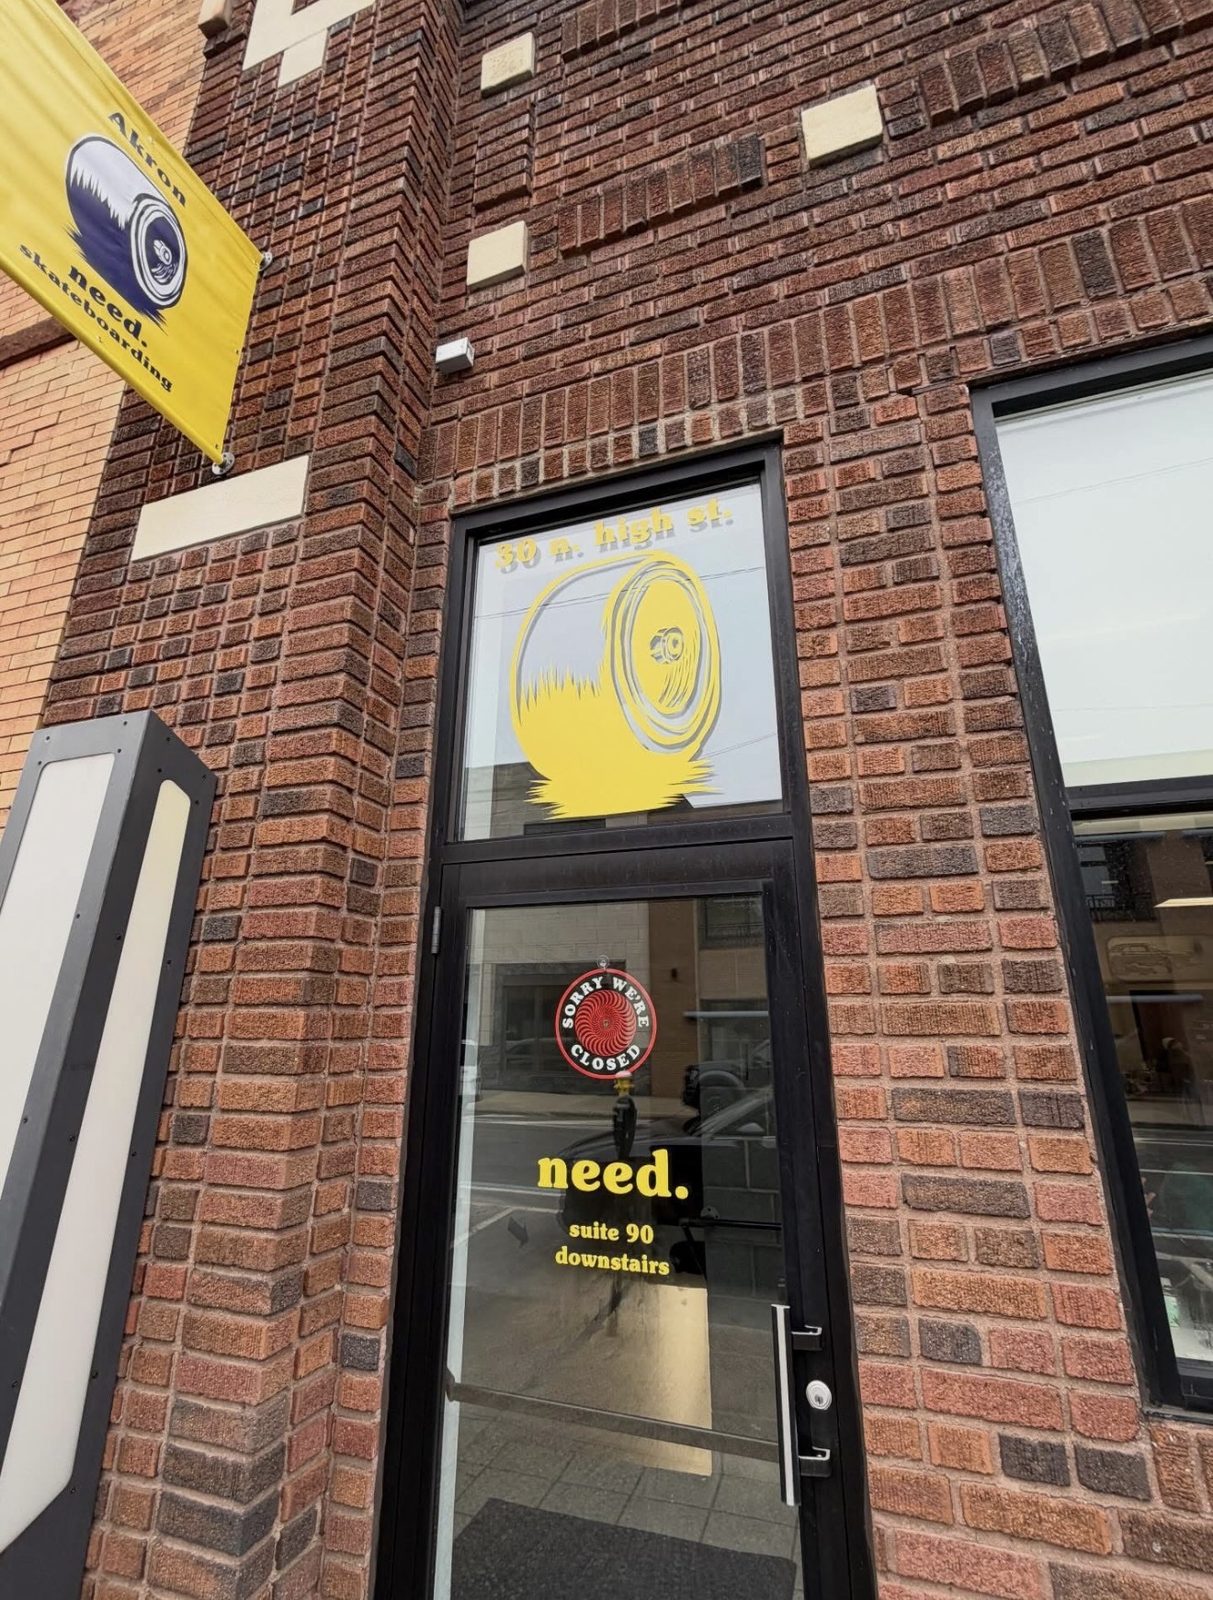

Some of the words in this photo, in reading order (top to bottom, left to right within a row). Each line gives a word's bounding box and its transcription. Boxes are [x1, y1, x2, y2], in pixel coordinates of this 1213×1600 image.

[108, 111, 187, 208] Akron
[19, 244, 173, 393] skateboarding
[67, 264, 148, 348] need.
[495, 537, 538, 569] 30
[548, 535, 580, 557] n.
[593, 508, 673, 545] high
[687, 497, 733, 526] st.
[562, 976, 603, 1029] SORRY
[612, 976, 650, 1028] WE'RE
[571, 1044, 641, 1071] CLOSED
[537, 1148, 689, 1199] need.
[569, 1221, 619, 1241] suite
[626, 1223, 654, 1244] 90
[555, 1246, 670, 1275] downstairs
